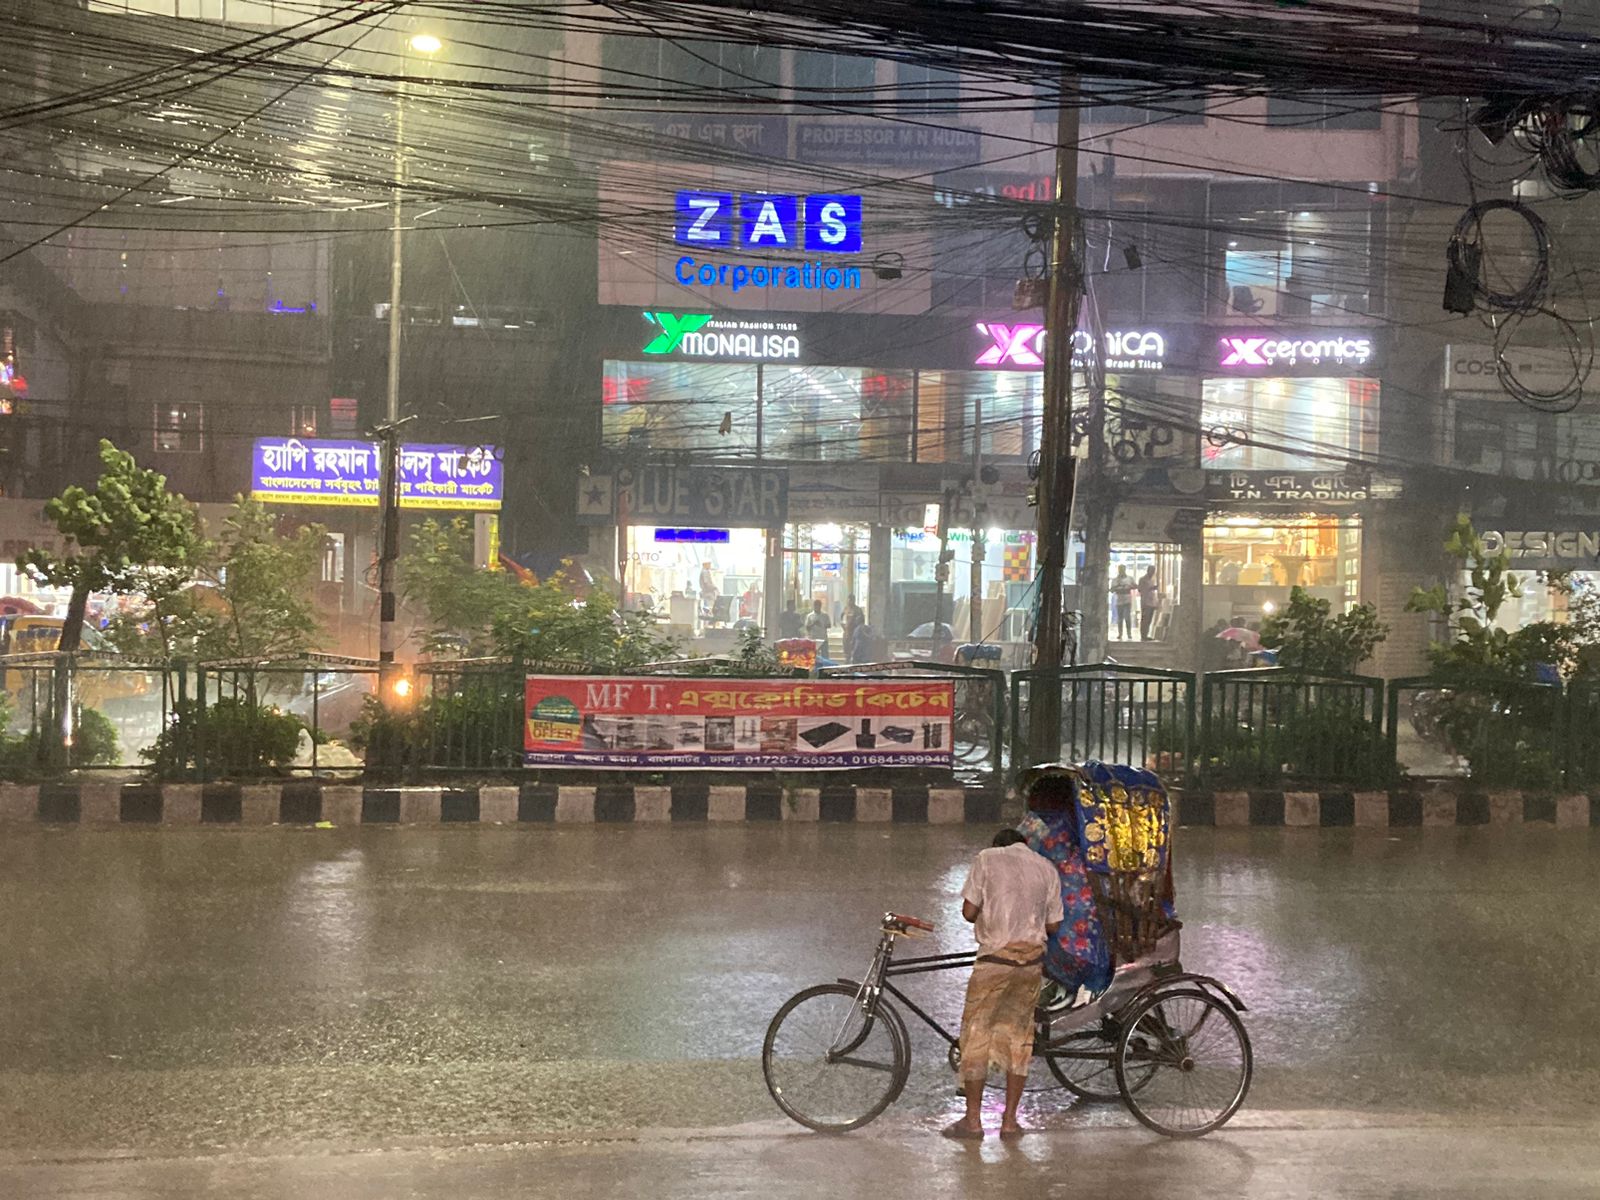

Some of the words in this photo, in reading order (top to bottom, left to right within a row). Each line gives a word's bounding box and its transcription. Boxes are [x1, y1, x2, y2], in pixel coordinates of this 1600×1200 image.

[801, 126, 895, 146] PROFESSOR
[674, 255, 862, 291] Corporation
[706, 320, 738, 330] ITALIAN
[739, 321, 774, 330] FASHION
[776, 323, 798, 331] TILES
[1262, 336, 1371, 359] ceramics
[1137, 359, 1164, 370] Tiles
[311, 446, 371, 477] রহমান
[1272, 490, 1367, 500] TRADING
[1478, 529, 1600, 559] DESIGN
[854, 686, 949, 709] কিচেন
